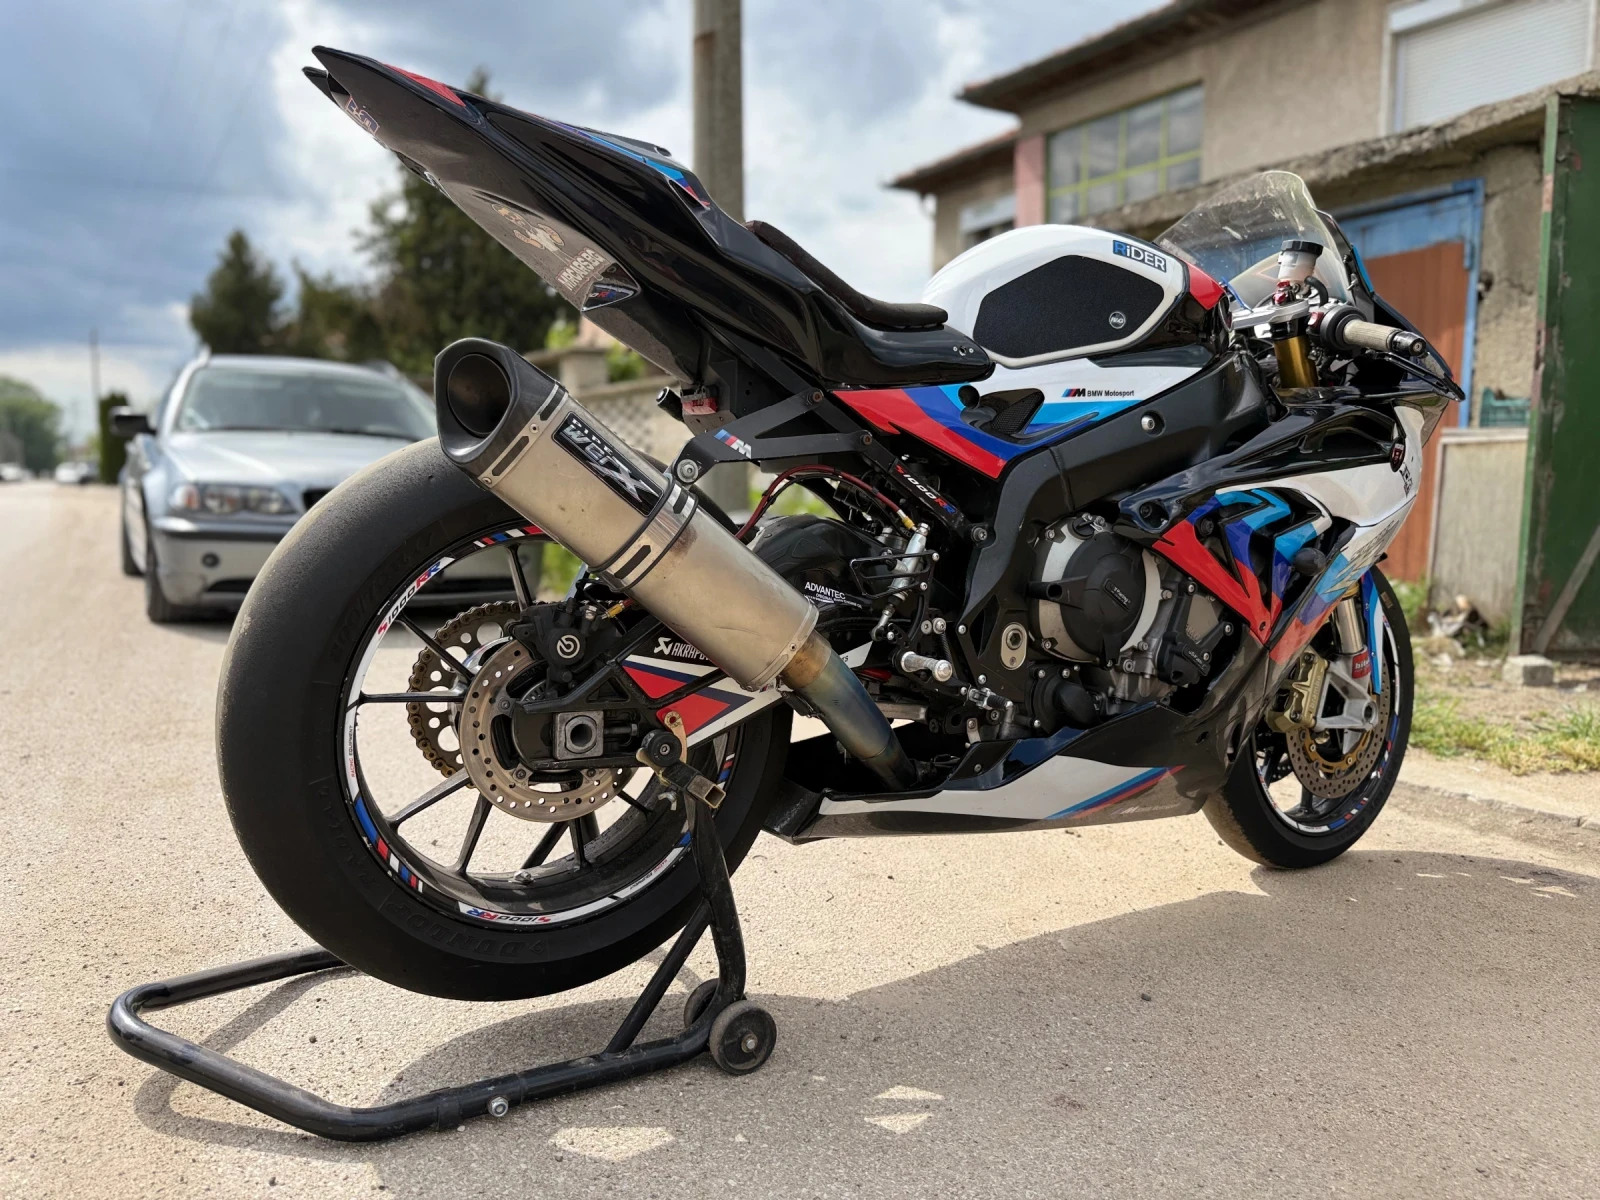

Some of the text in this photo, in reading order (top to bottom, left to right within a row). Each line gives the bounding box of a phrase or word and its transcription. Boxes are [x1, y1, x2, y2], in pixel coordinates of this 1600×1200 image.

[378, 561, 441, 635] S1000RR
[804, 581, 846, 600] ADVANTEC
[386, 900, 527, 957] DUNLOP
[466, 907, 552, 924] S1000RR
